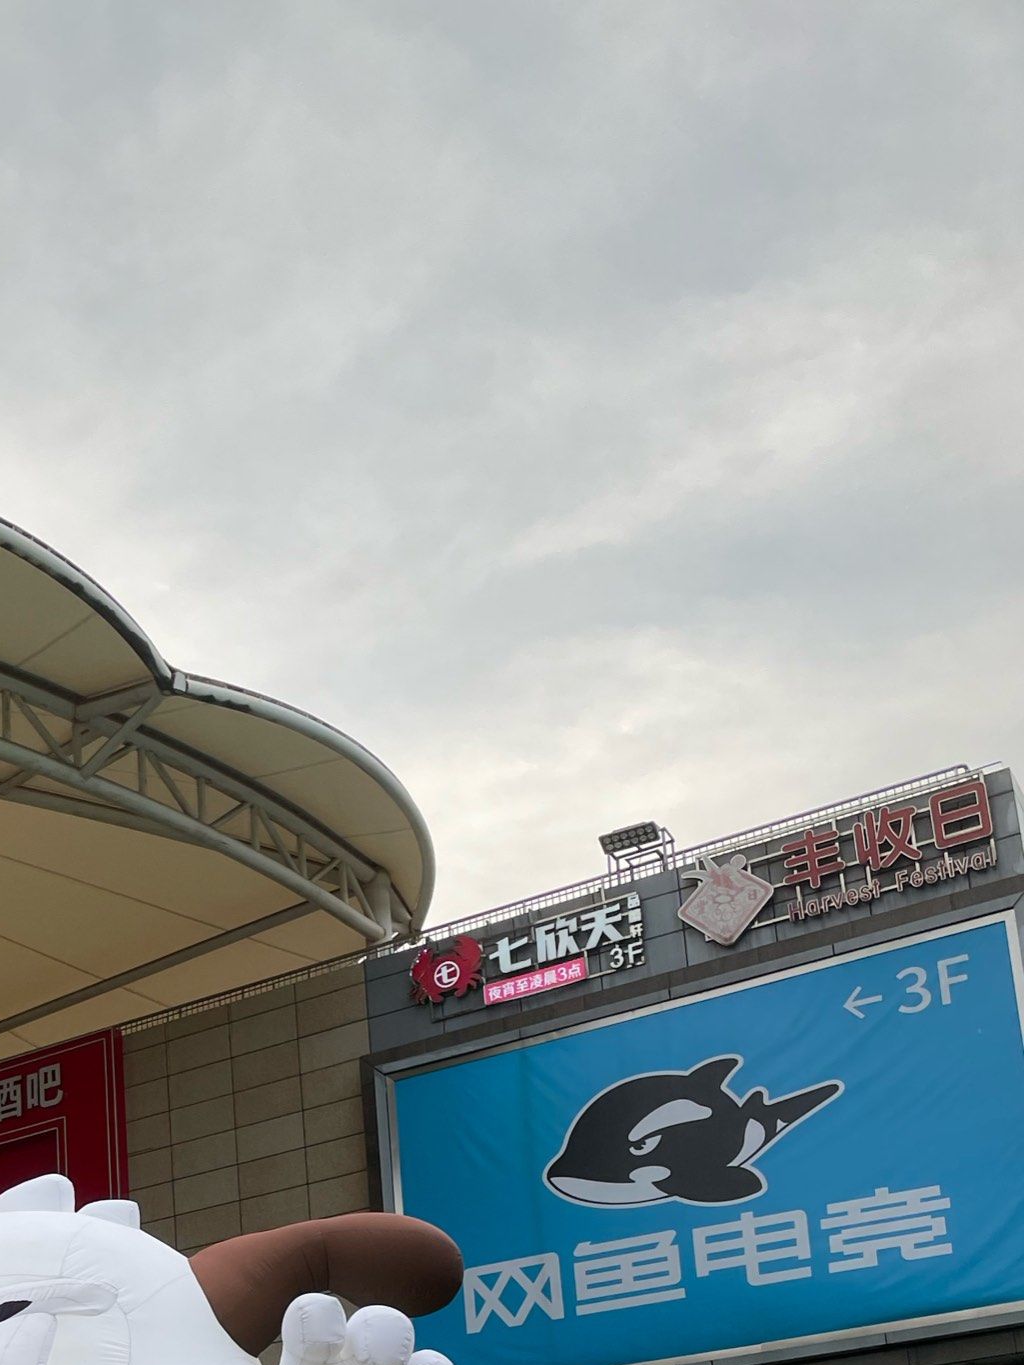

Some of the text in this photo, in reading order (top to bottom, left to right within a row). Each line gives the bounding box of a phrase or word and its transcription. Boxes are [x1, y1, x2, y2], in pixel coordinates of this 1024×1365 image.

[781, 781, 993, 888] 丰收日
[788, 844, 997, 922] Harvest Festival
[489, 902, 625, 974] 七欣天
[609, 938, 644, 970] 3F
[487, 966, 582, 1001] 夜宵至凌晨3点
[897, 954, 969, 1014] 3F
[464, 1185, 952, 1334] 网鱼电竞
